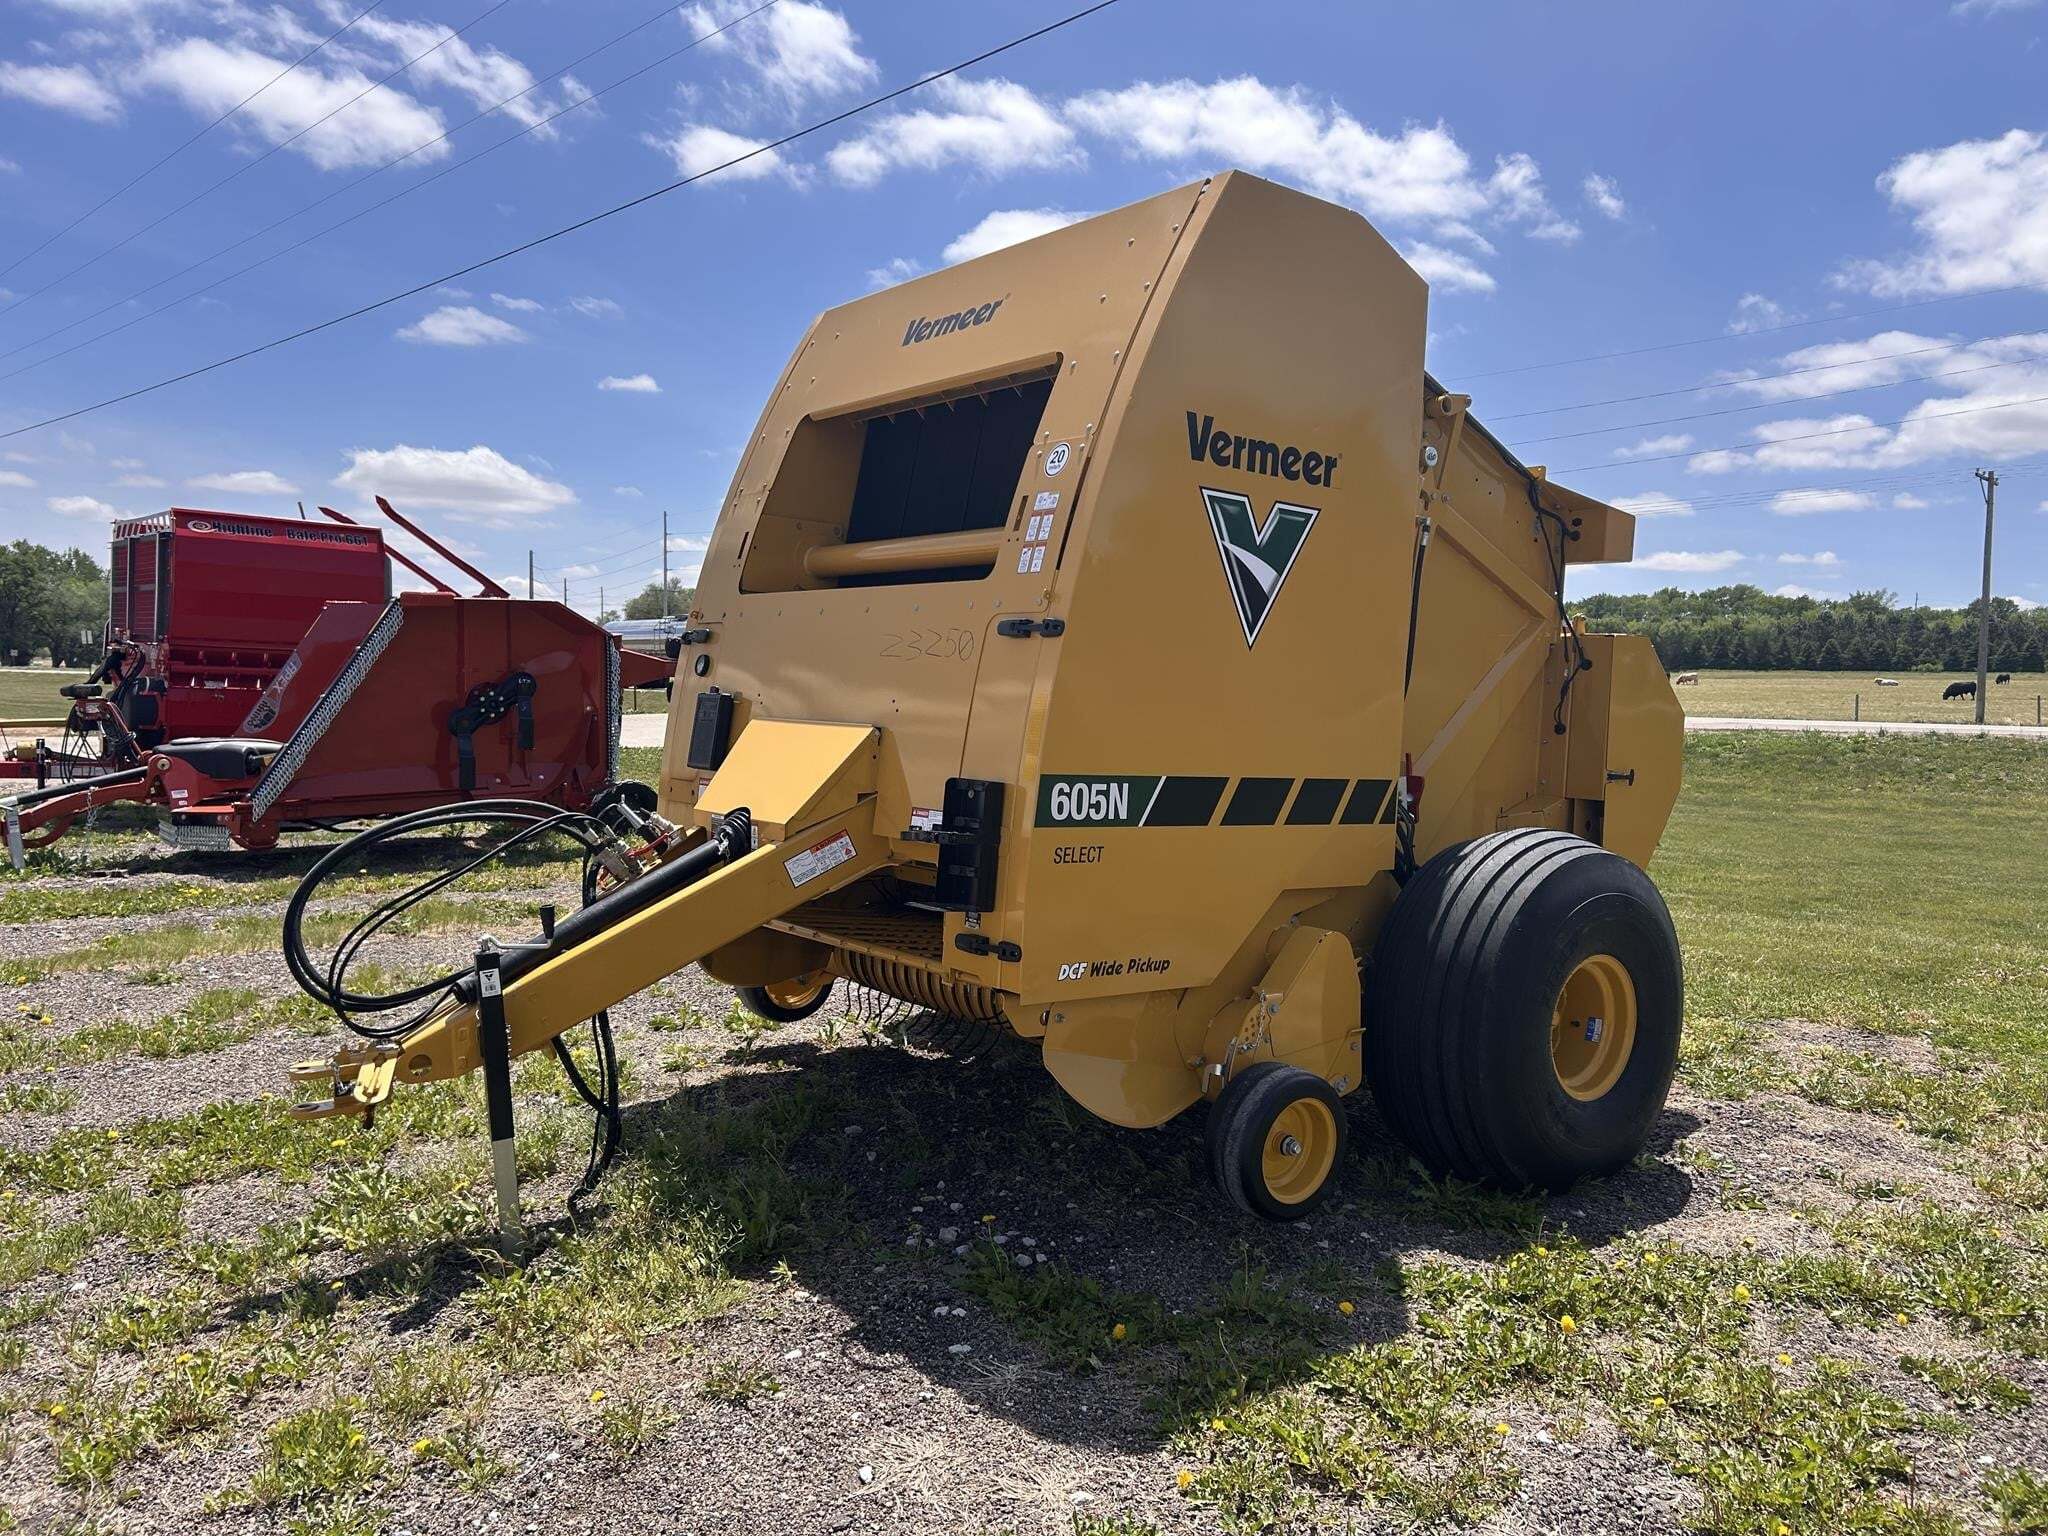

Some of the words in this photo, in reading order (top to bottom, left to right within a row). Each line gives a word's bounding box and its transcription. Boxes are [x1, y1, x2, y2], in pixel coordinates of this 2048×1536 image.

[902, 298, 1004, 347] Vermeer
[1049, 449, 1066, 464] 20
[1186, 410, 1338, 488] Vermeer
[212, 520, 273, 538] Highline
[879, 627, 975, 662] 23250
[1050, 782, 1129, 820] 605N
[1053, 846, 1104, 865] SELECT
[1057, 961, 1088, 981] DCF
[1089, 959, 1124, 978] Wide
[1126, 957, 1171, 975] Pickup
